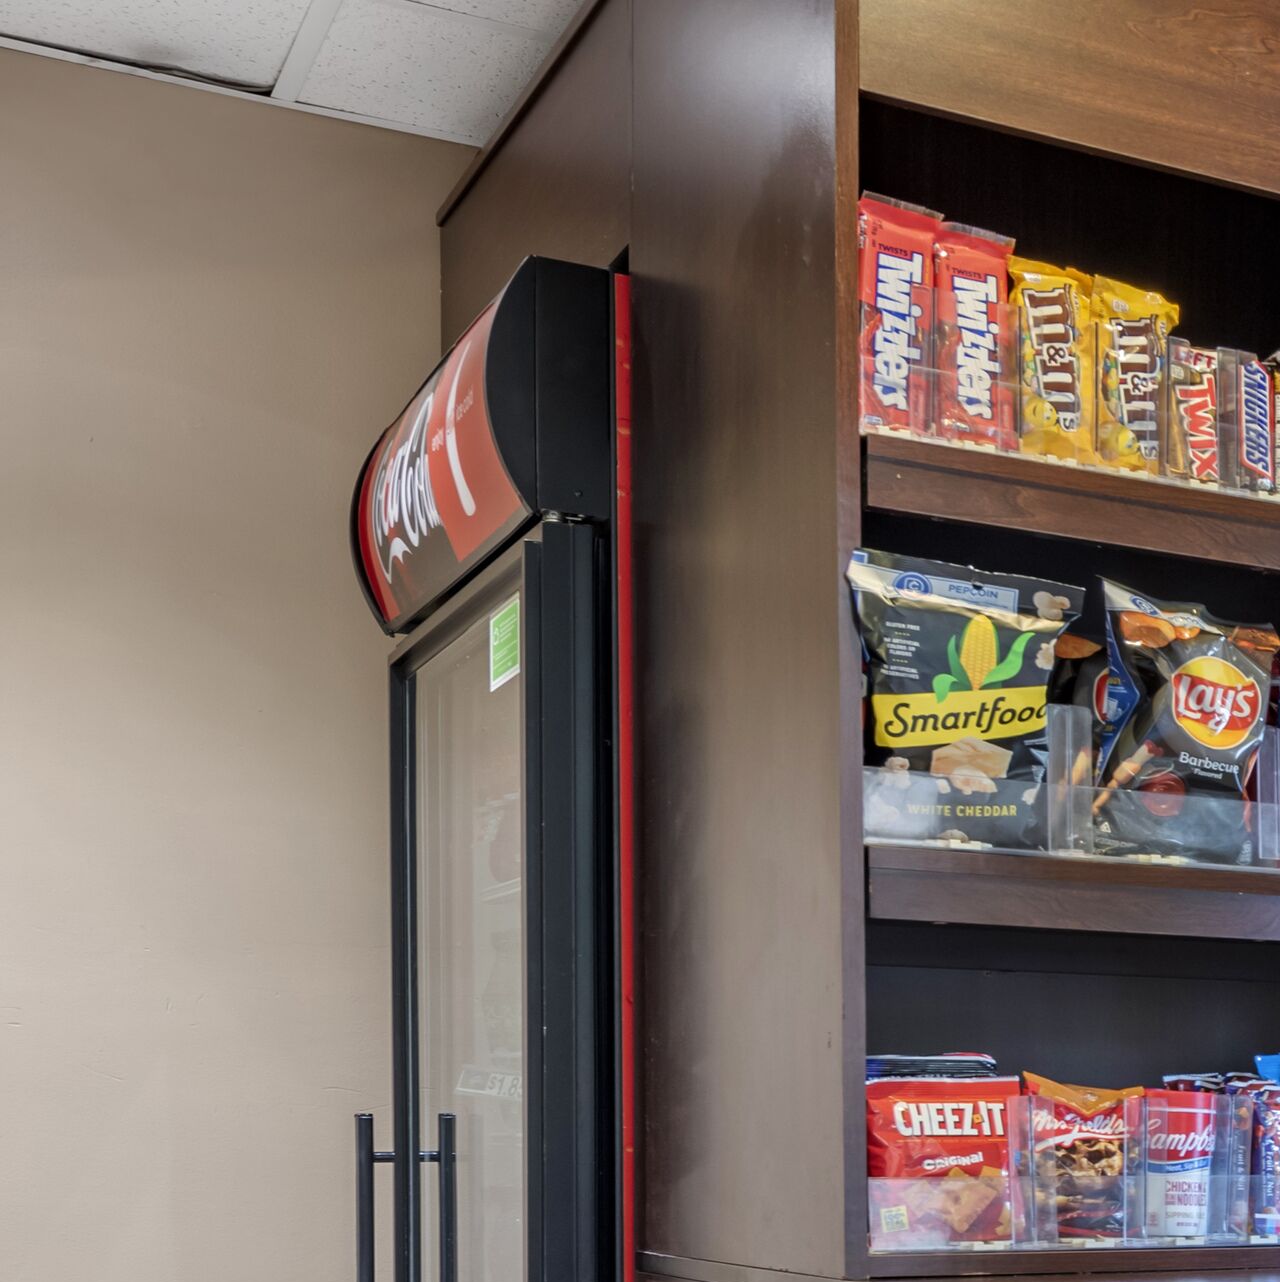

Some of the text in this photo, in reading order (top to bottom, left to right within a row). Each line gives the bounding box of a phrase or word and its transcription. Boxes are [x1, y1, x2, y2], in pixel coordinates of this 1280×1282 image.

[878, 242, 909, 257] TWISTS
[952, 267, 983, 279] TWISTS
[872, 251, 924, 411] Twizzlers
[952, 274, 1002, 420] Twizzlers
[1175, 373, 1219, 480] TWIX
[1243, 362, 1271, 474] SNICKERS
[948, 583, 999, 599] PEPCOIN
[1176, 675, 1255, 737] Lay's
[1178, 751, 1240, 775] Barbecue
[907, 804, 1018, 818] WHITE CHEDDAR
[487, 1071, 522, 1098] $1.8
[1166, 1181, 1203, 1193] CHICKEN
